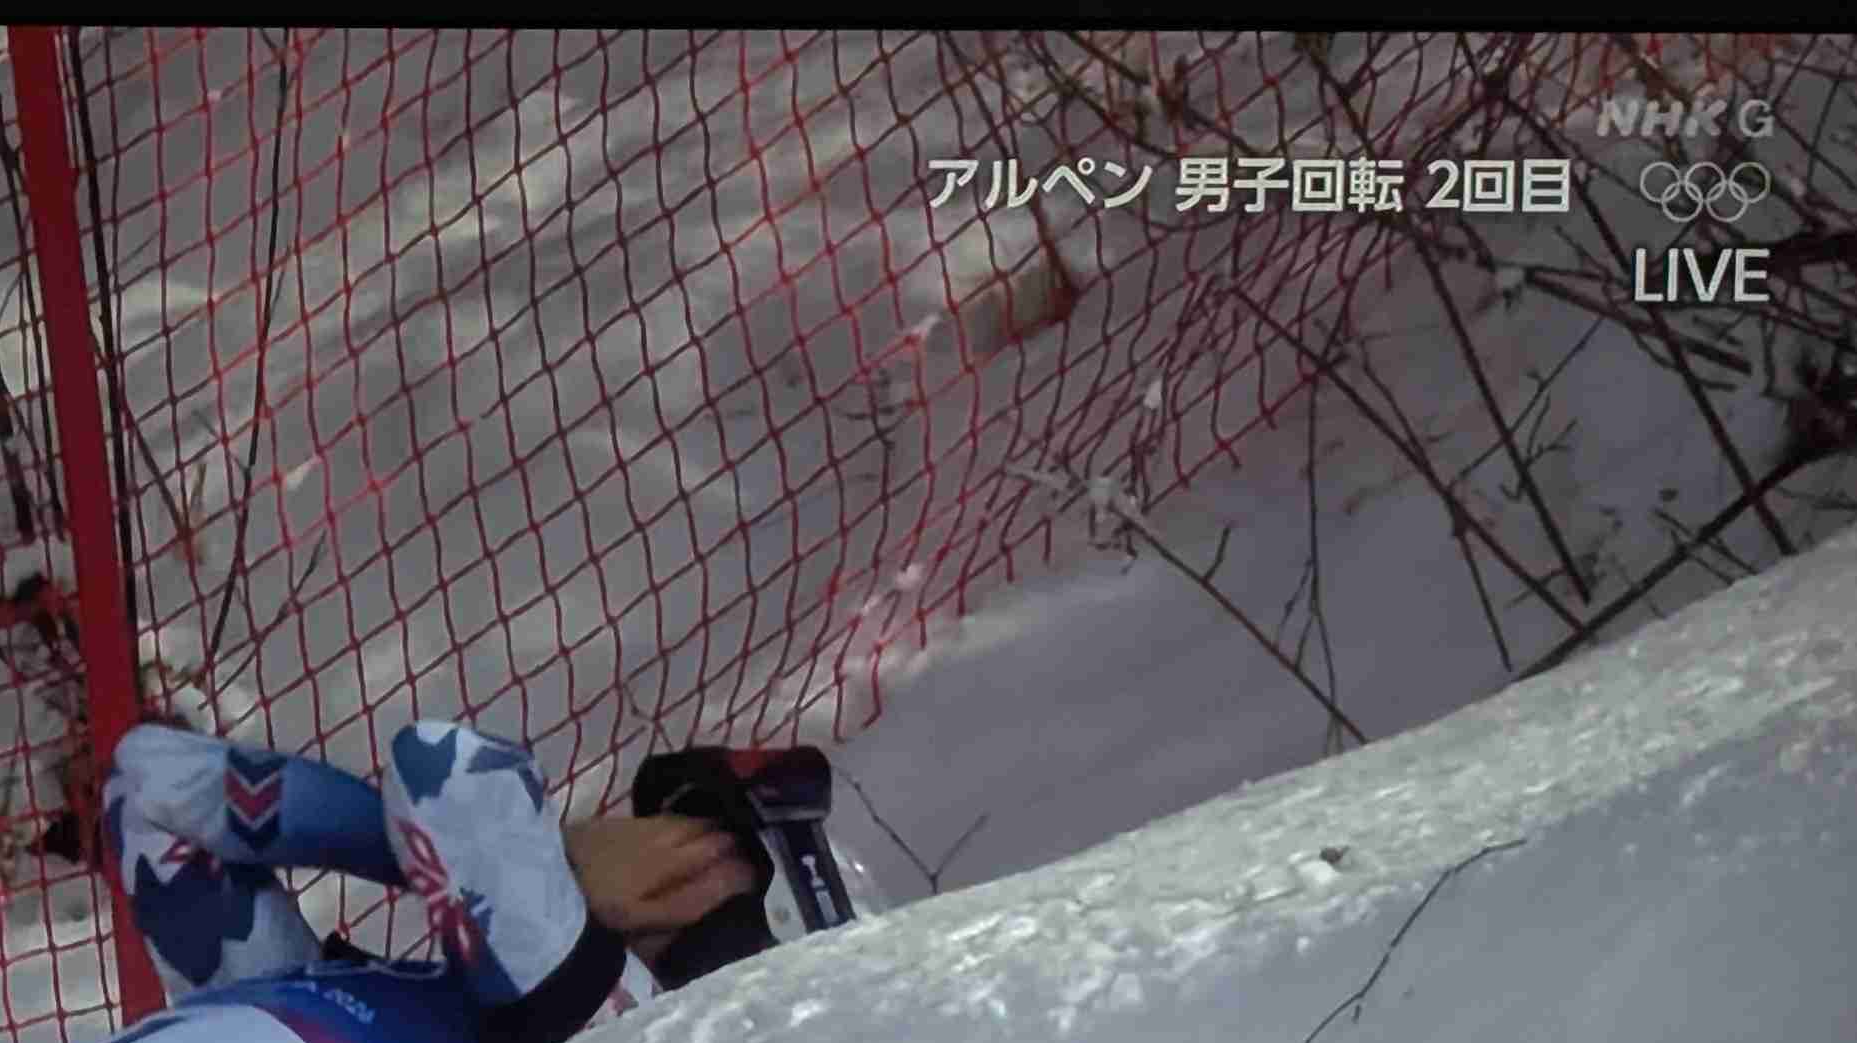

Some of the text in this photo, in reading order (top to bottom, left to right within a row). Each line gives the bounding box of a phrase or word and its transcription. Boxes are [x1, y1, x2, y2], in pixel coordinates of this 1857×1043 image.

[1596, 99, 1775, 137] NHK G
[927, 156, 1571, 213] アルペン 男子回転 2回目
[1634, 247, 1771, 303] LIVE
